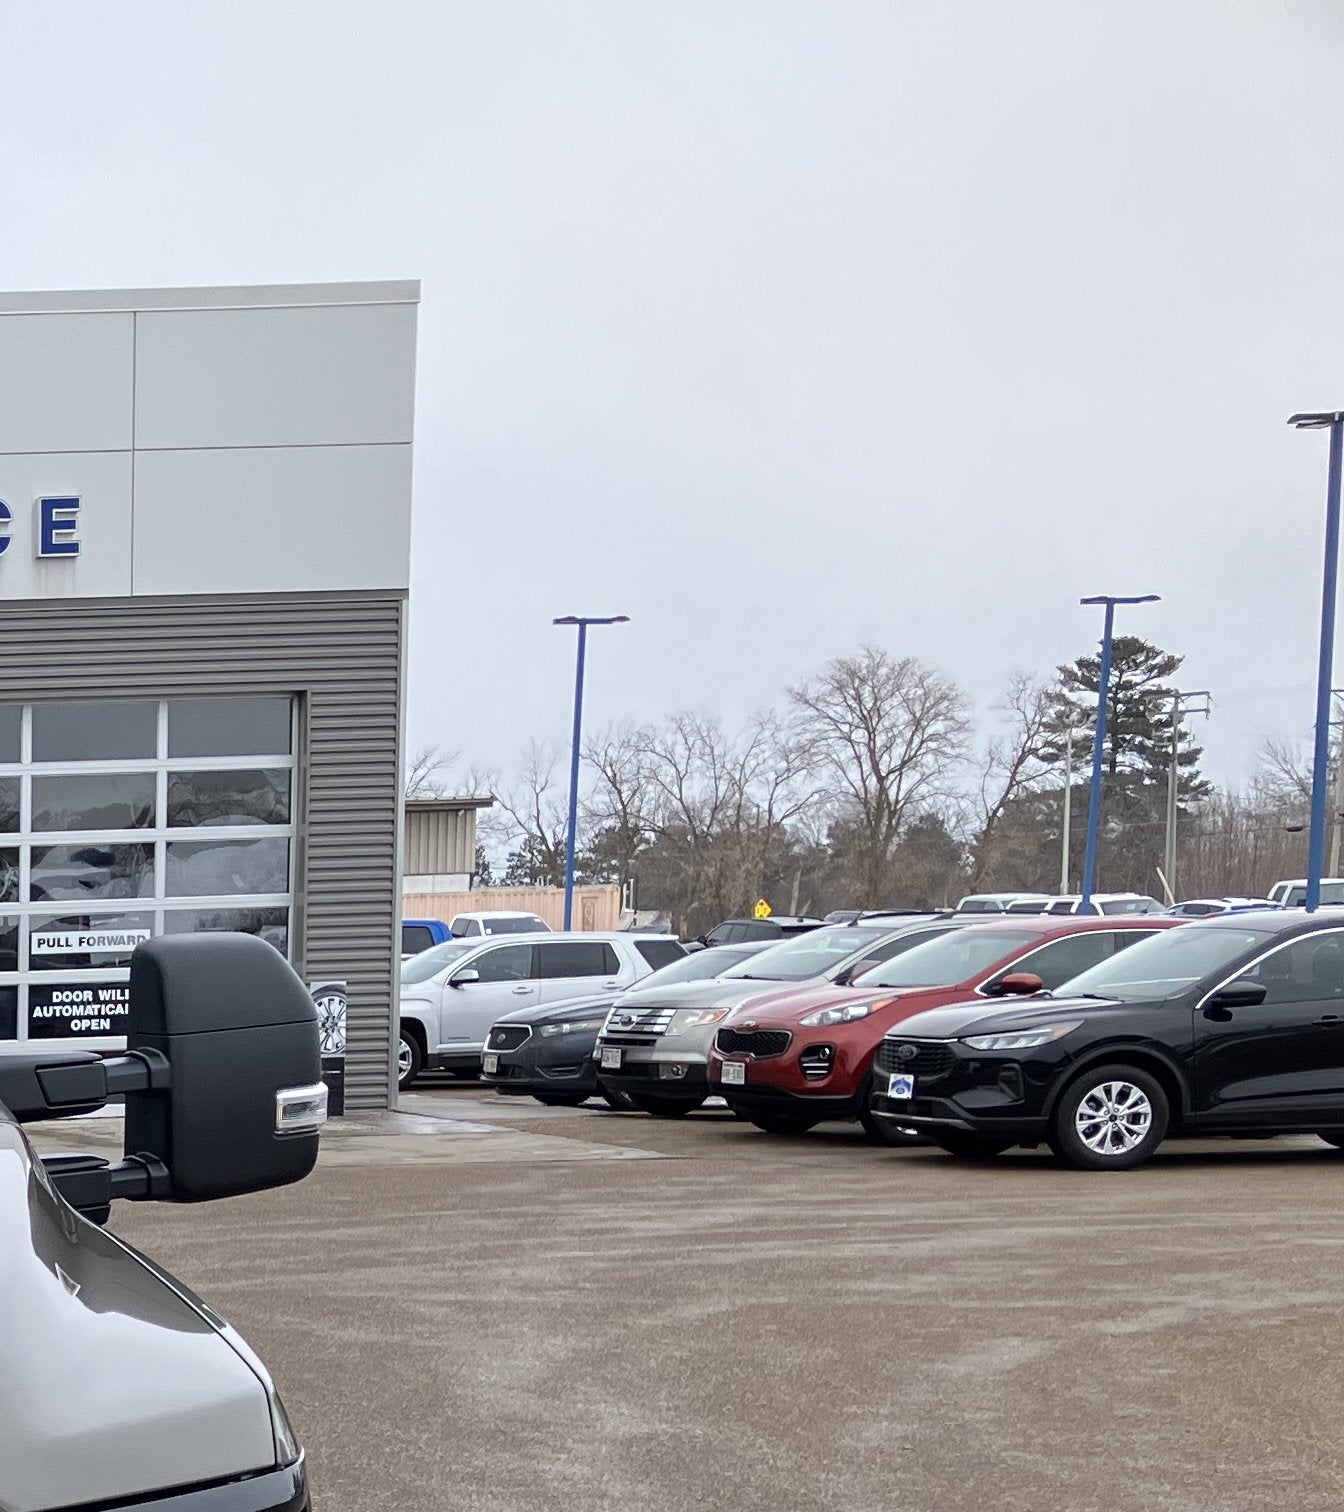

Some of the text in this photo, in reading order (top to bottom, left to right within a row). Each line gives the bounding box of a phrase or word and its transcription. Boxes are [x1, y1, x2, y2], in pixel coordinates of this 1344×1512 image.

[37, 934, 146, 949] PULL FORWARD
[52, 990, 93, 1003] DOOR
[32, 1003, 129, 1018] AUTOMATICA
[70, 1018, 111, 1031] OPEN
